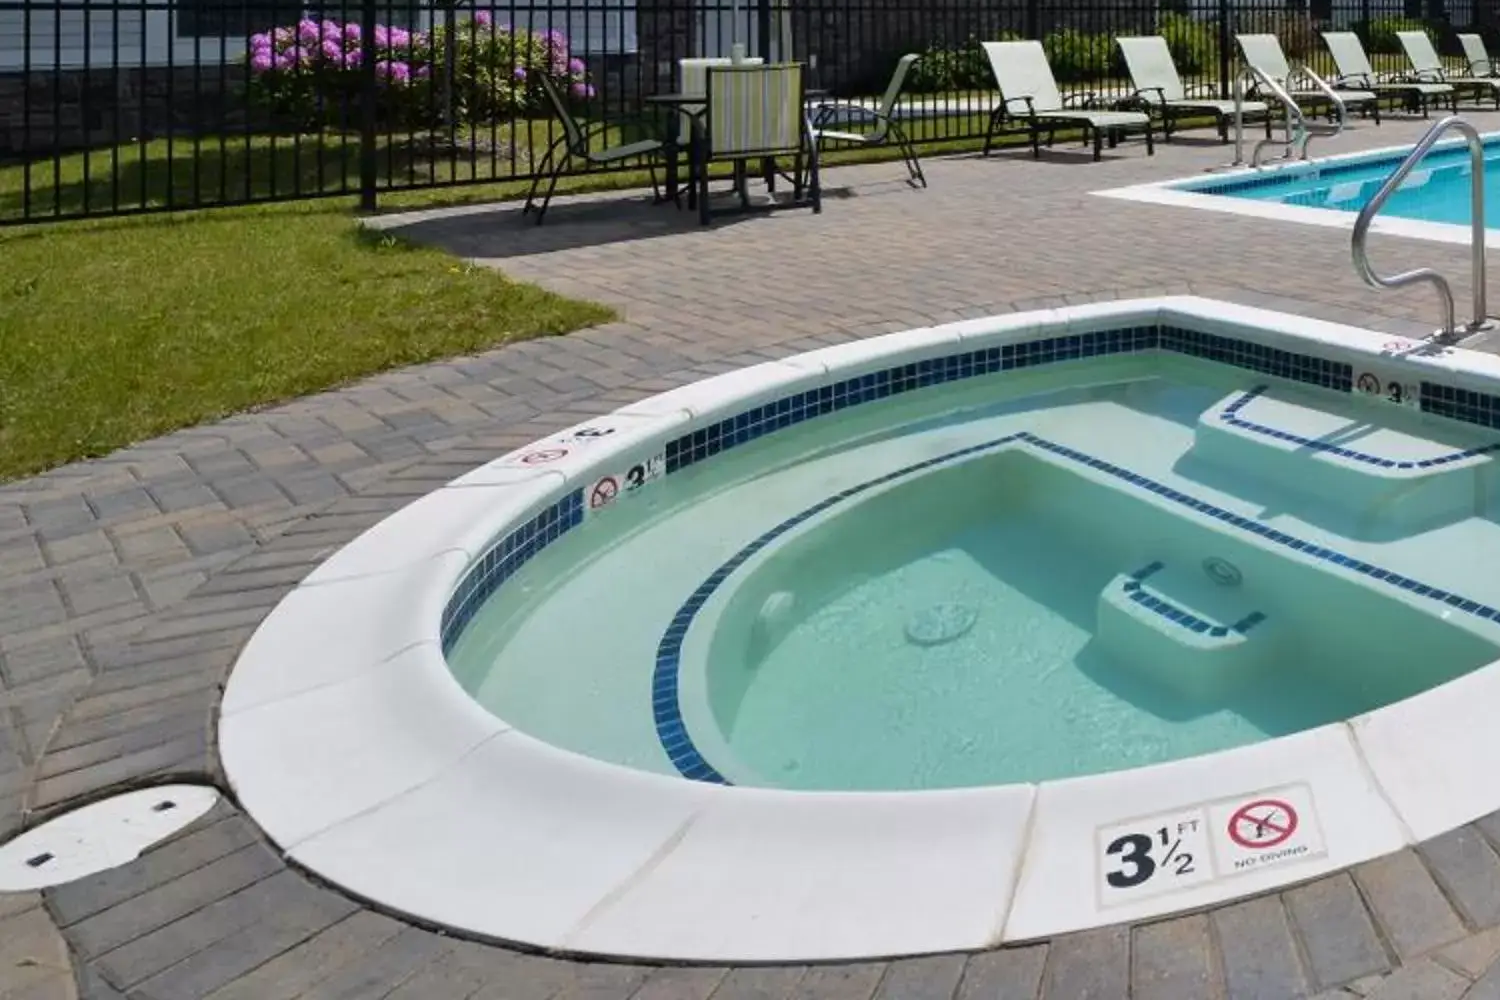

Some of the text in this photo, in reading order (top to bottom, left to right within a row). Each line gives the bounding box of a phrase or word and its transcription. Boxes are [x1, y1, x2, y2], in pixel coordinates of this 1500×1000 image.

[1106, 833, 1156, 888] 3
[1177, 819, 1200, 835] FT
[1234, 846, 1309, 869] NO DIVING
